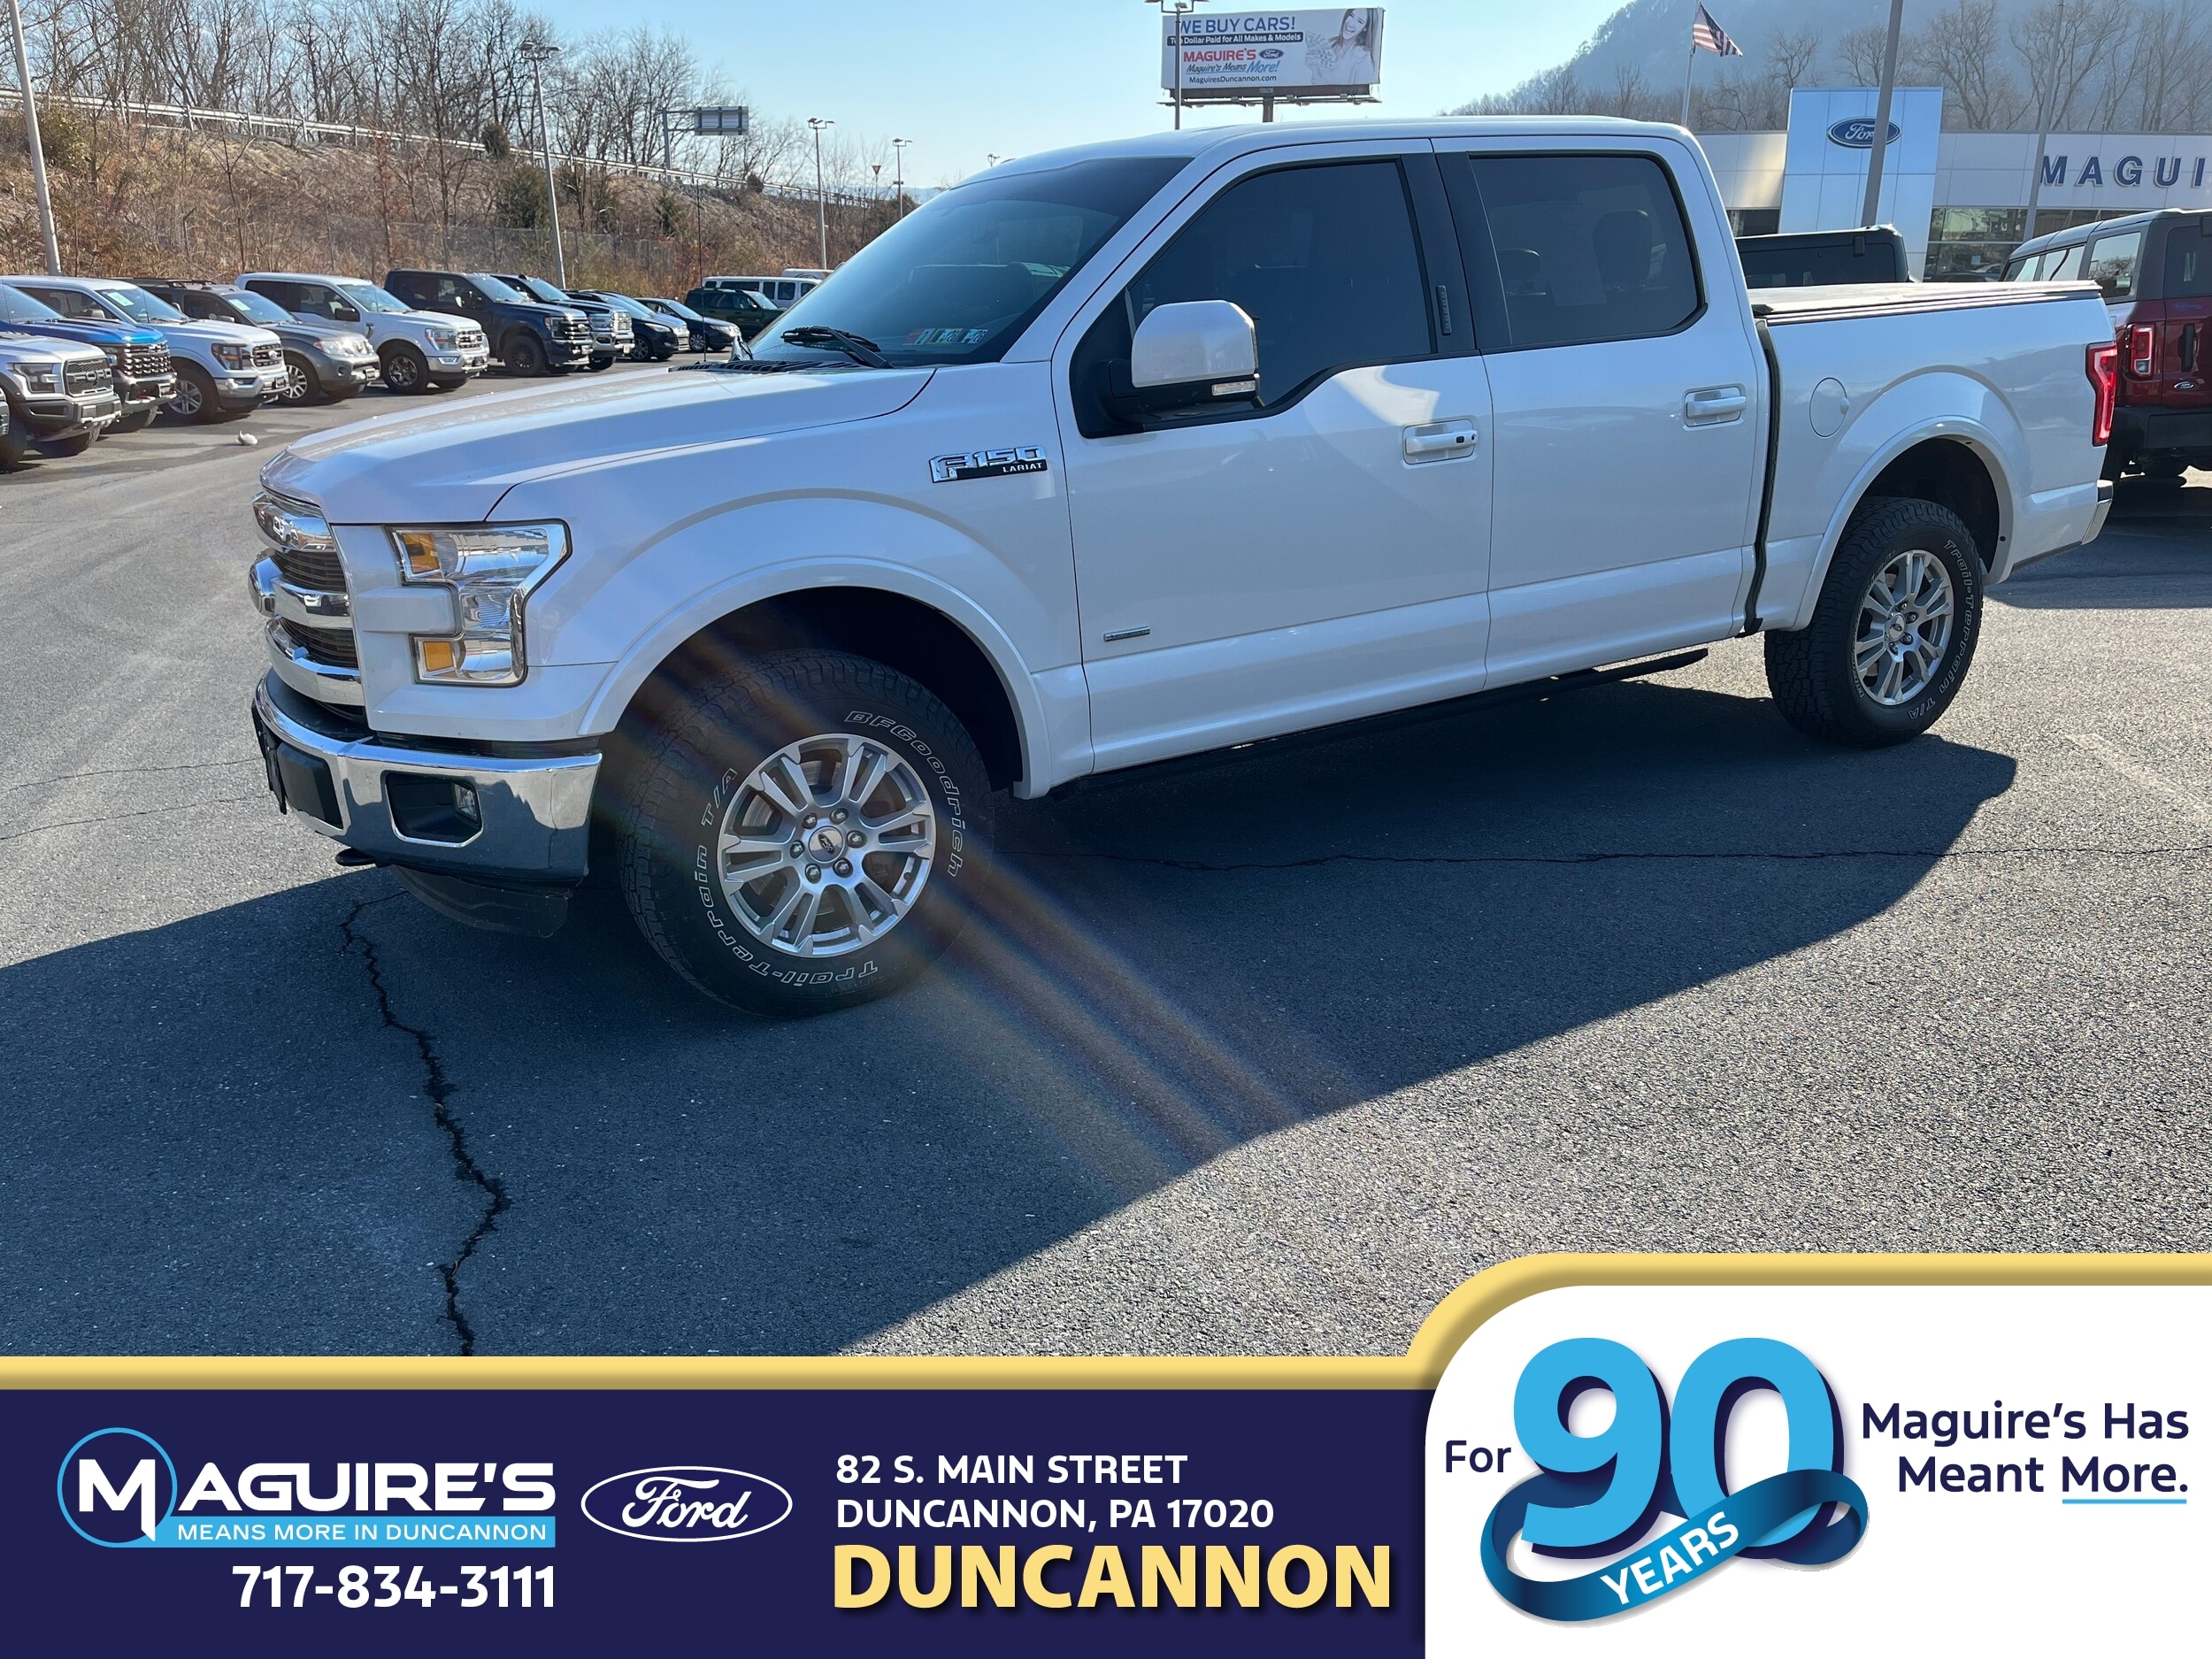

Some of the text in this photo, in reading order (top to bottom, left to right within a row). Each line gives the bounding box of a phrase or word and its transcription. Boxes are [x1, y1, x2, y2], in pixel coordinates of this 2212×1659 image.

[1180, 17, 1295, 34] WE BUY CARS!
[1244, 34, 1267, 42] Makes
[1275, 33, 1302, 42] Models
[1183, 48, 1256, 62] MAGUIRE'S
[1187, 60, 1281, 75] Maguire's Means More!
[1188, 75, 1278, 85] MaguiresDuncannon.com
[1845, 123, 1876, 141] For
[2039, 155, 2207, 188] MAGUI
[1002, 462, 1042, 473] LARIAT
[844, 710, 968, 878] BFGoodrich
[693, 843, 878, 987] Trail-Terrain
